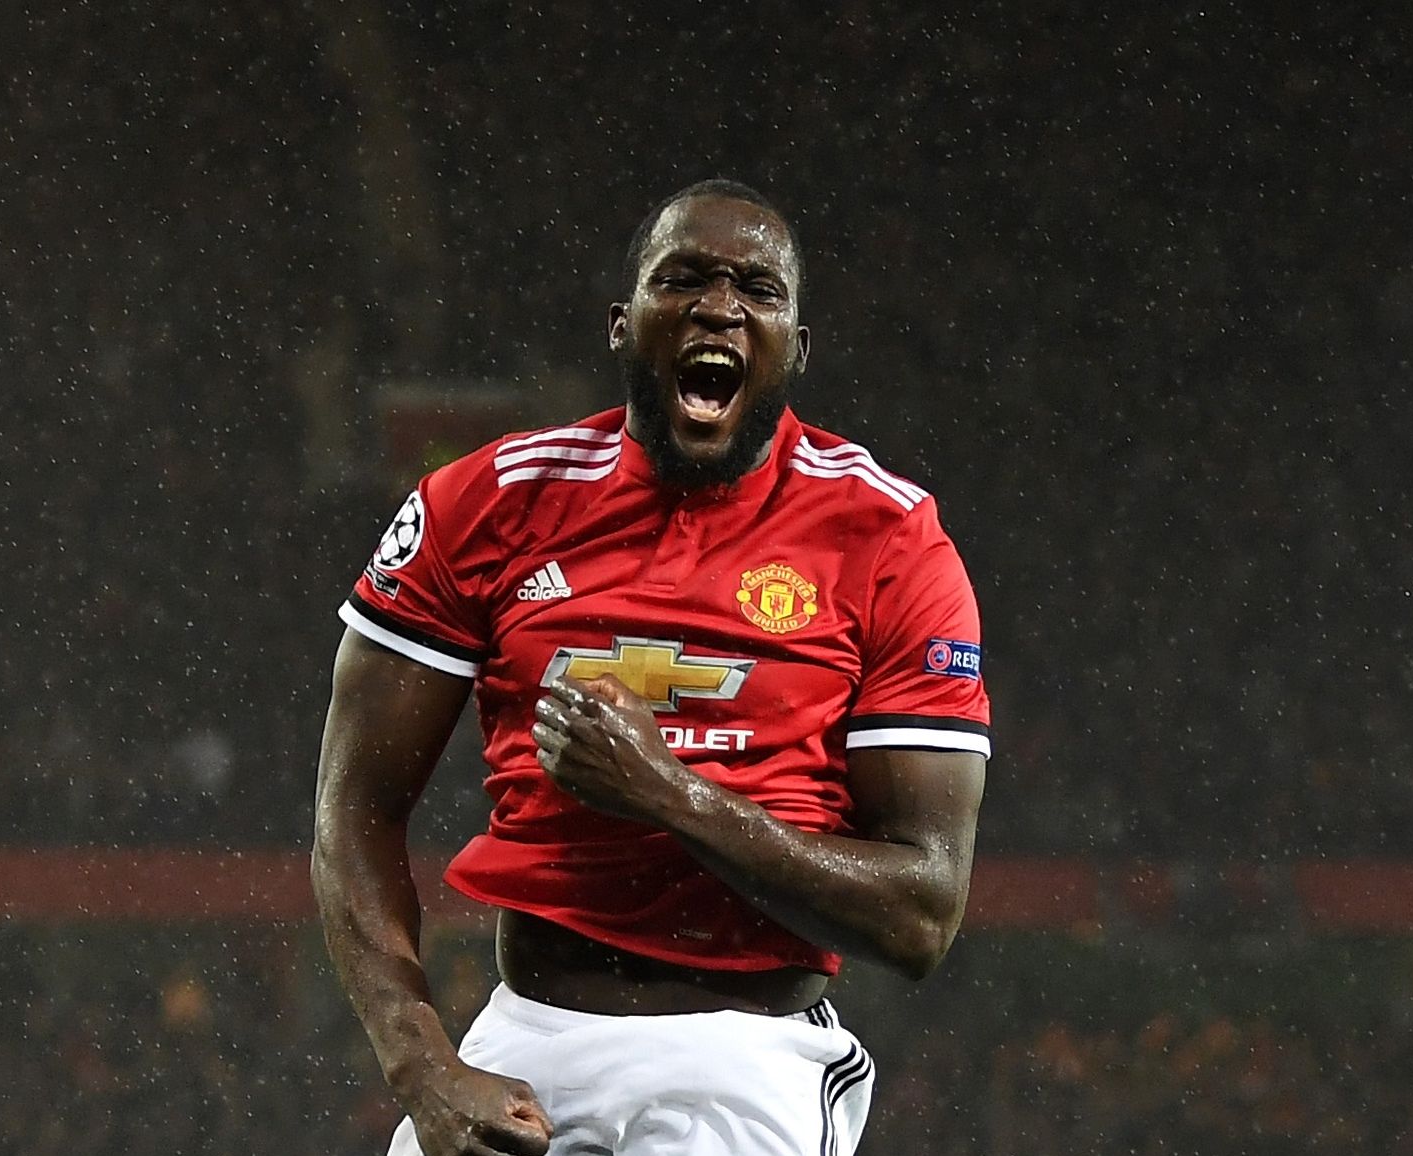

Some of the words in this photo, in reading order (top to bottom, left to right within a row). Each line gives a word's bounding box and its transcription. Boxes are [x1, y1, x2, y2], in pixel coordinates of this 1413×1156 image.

[747, 570, 811, 598] MANCHESTER
[517, 585, 572, 601] adidas
[752, 612, 798, 627] UNITED
